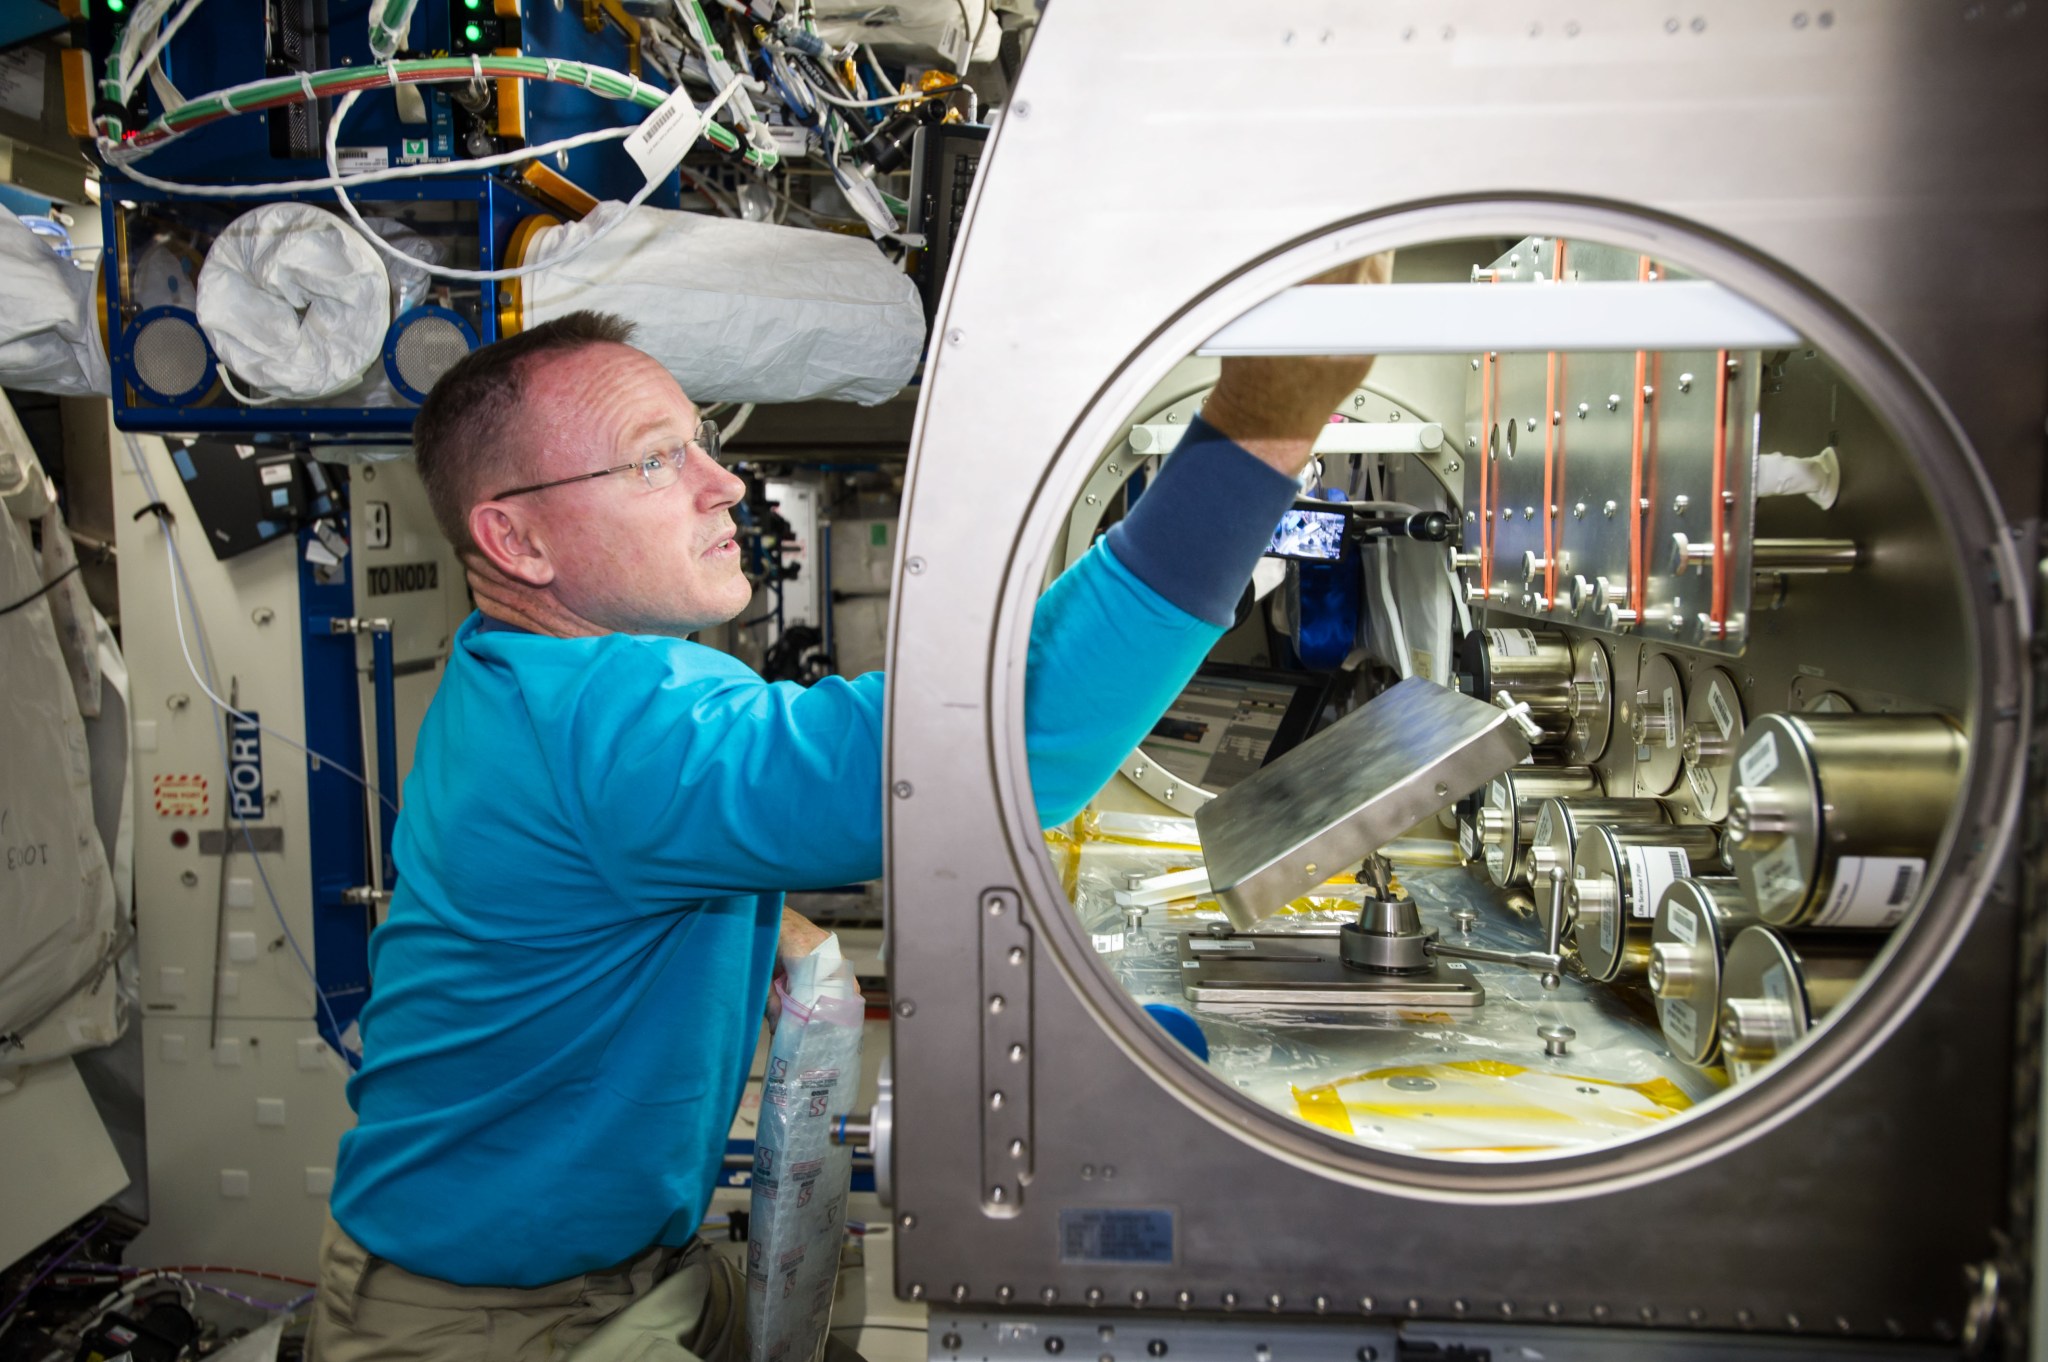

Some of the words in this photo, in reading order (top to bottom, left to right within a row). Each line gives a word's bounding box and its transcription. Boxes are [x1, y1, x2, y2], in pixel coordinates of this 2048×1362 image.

[369, 567, 391, 596] TO
[394, 564, 426, 592] NOD
[428, 561, 438, 589] 2
[232, 719, 261, 814] PORT
